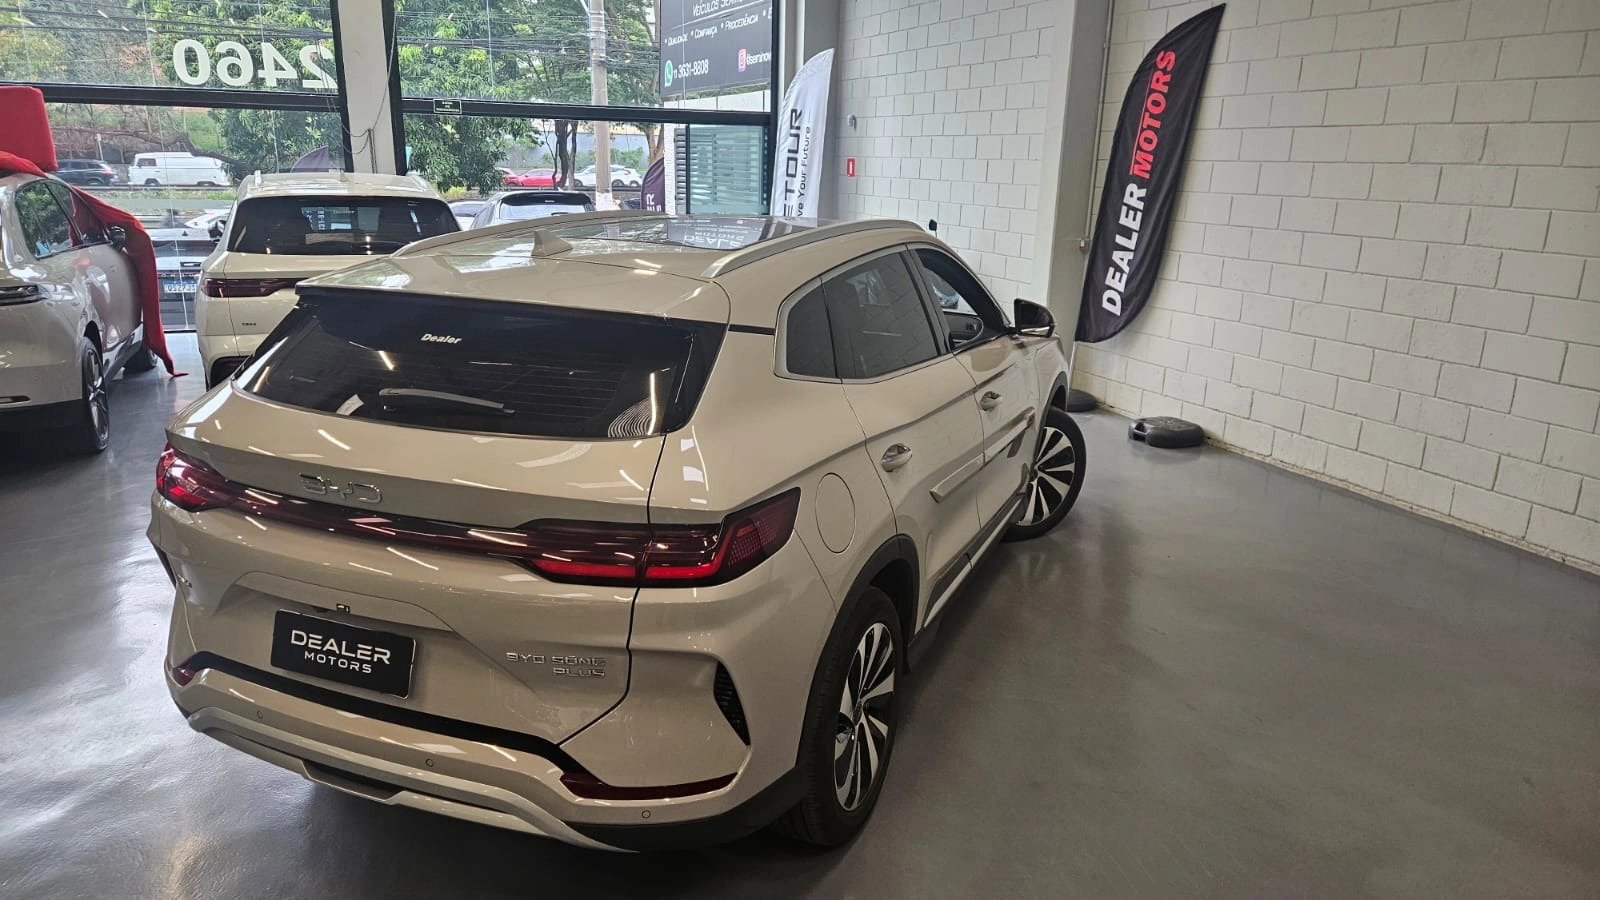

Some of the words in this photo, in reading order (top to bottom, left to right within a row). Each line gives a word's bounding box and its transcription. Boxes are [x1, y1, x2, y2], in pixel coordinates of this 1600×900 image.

[800, 126, 811, 167] Future
[797, 172, 807, 199] Your
[1101, 182, 1148, 316] DEALER
[1132, 50, 1177, 180] MOTORS
[420, 333, 463, 344] Dealer
[299, 472, 383, 504] BYD
[290, 629, 391, 665] DEALER
[505, 652, 545, 664] BYD
[551, 655, 606, 666] SONG
[304, 650, 372, 674] MOTORS
[553, 667, 605, 677] PLUS
